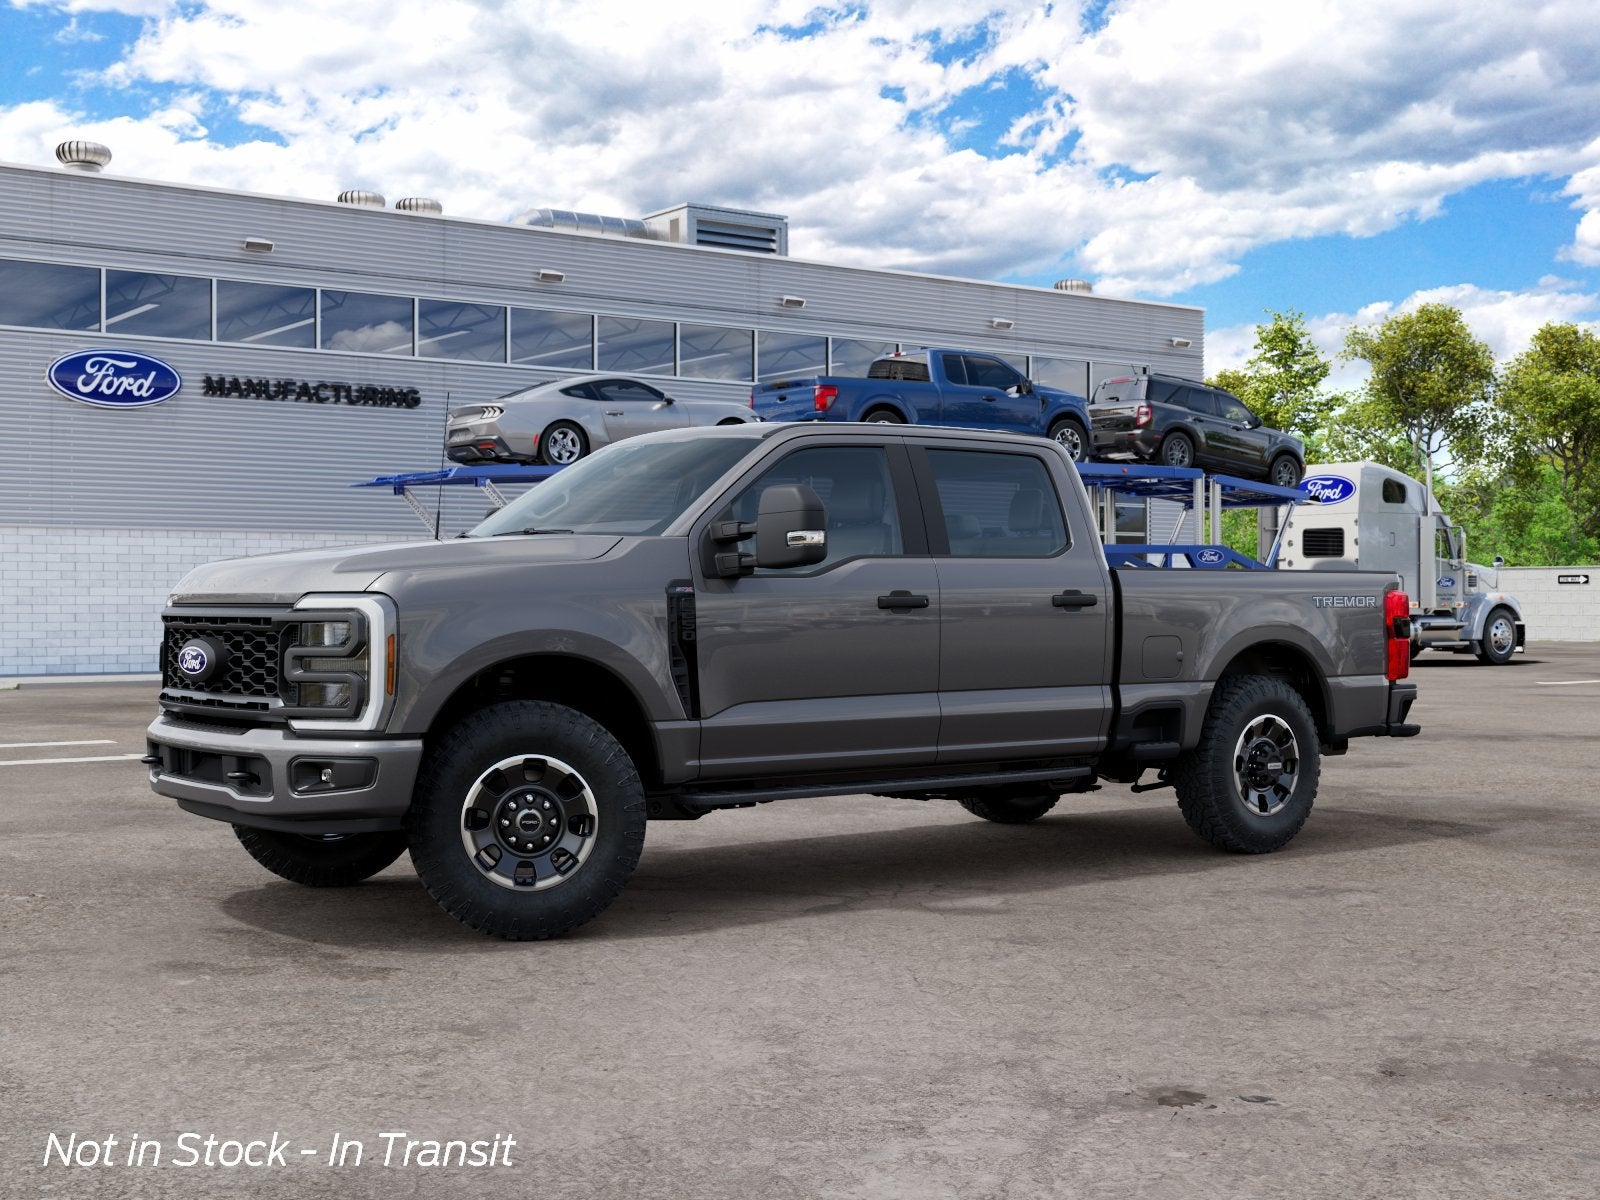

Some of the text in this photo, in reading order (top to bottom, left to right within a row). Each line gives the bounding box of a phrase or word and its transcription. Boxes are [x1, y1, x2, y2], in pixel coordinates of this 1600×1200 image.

[77, 357, 421, 409] Ford MANUFACTURING
[1305, 479, 1343, 500] Ford
[1201, 550, 1220, 561] Ford
[1312, 596, 1377, 608] TREMOR
[183, 650, 201, 670] Ford
